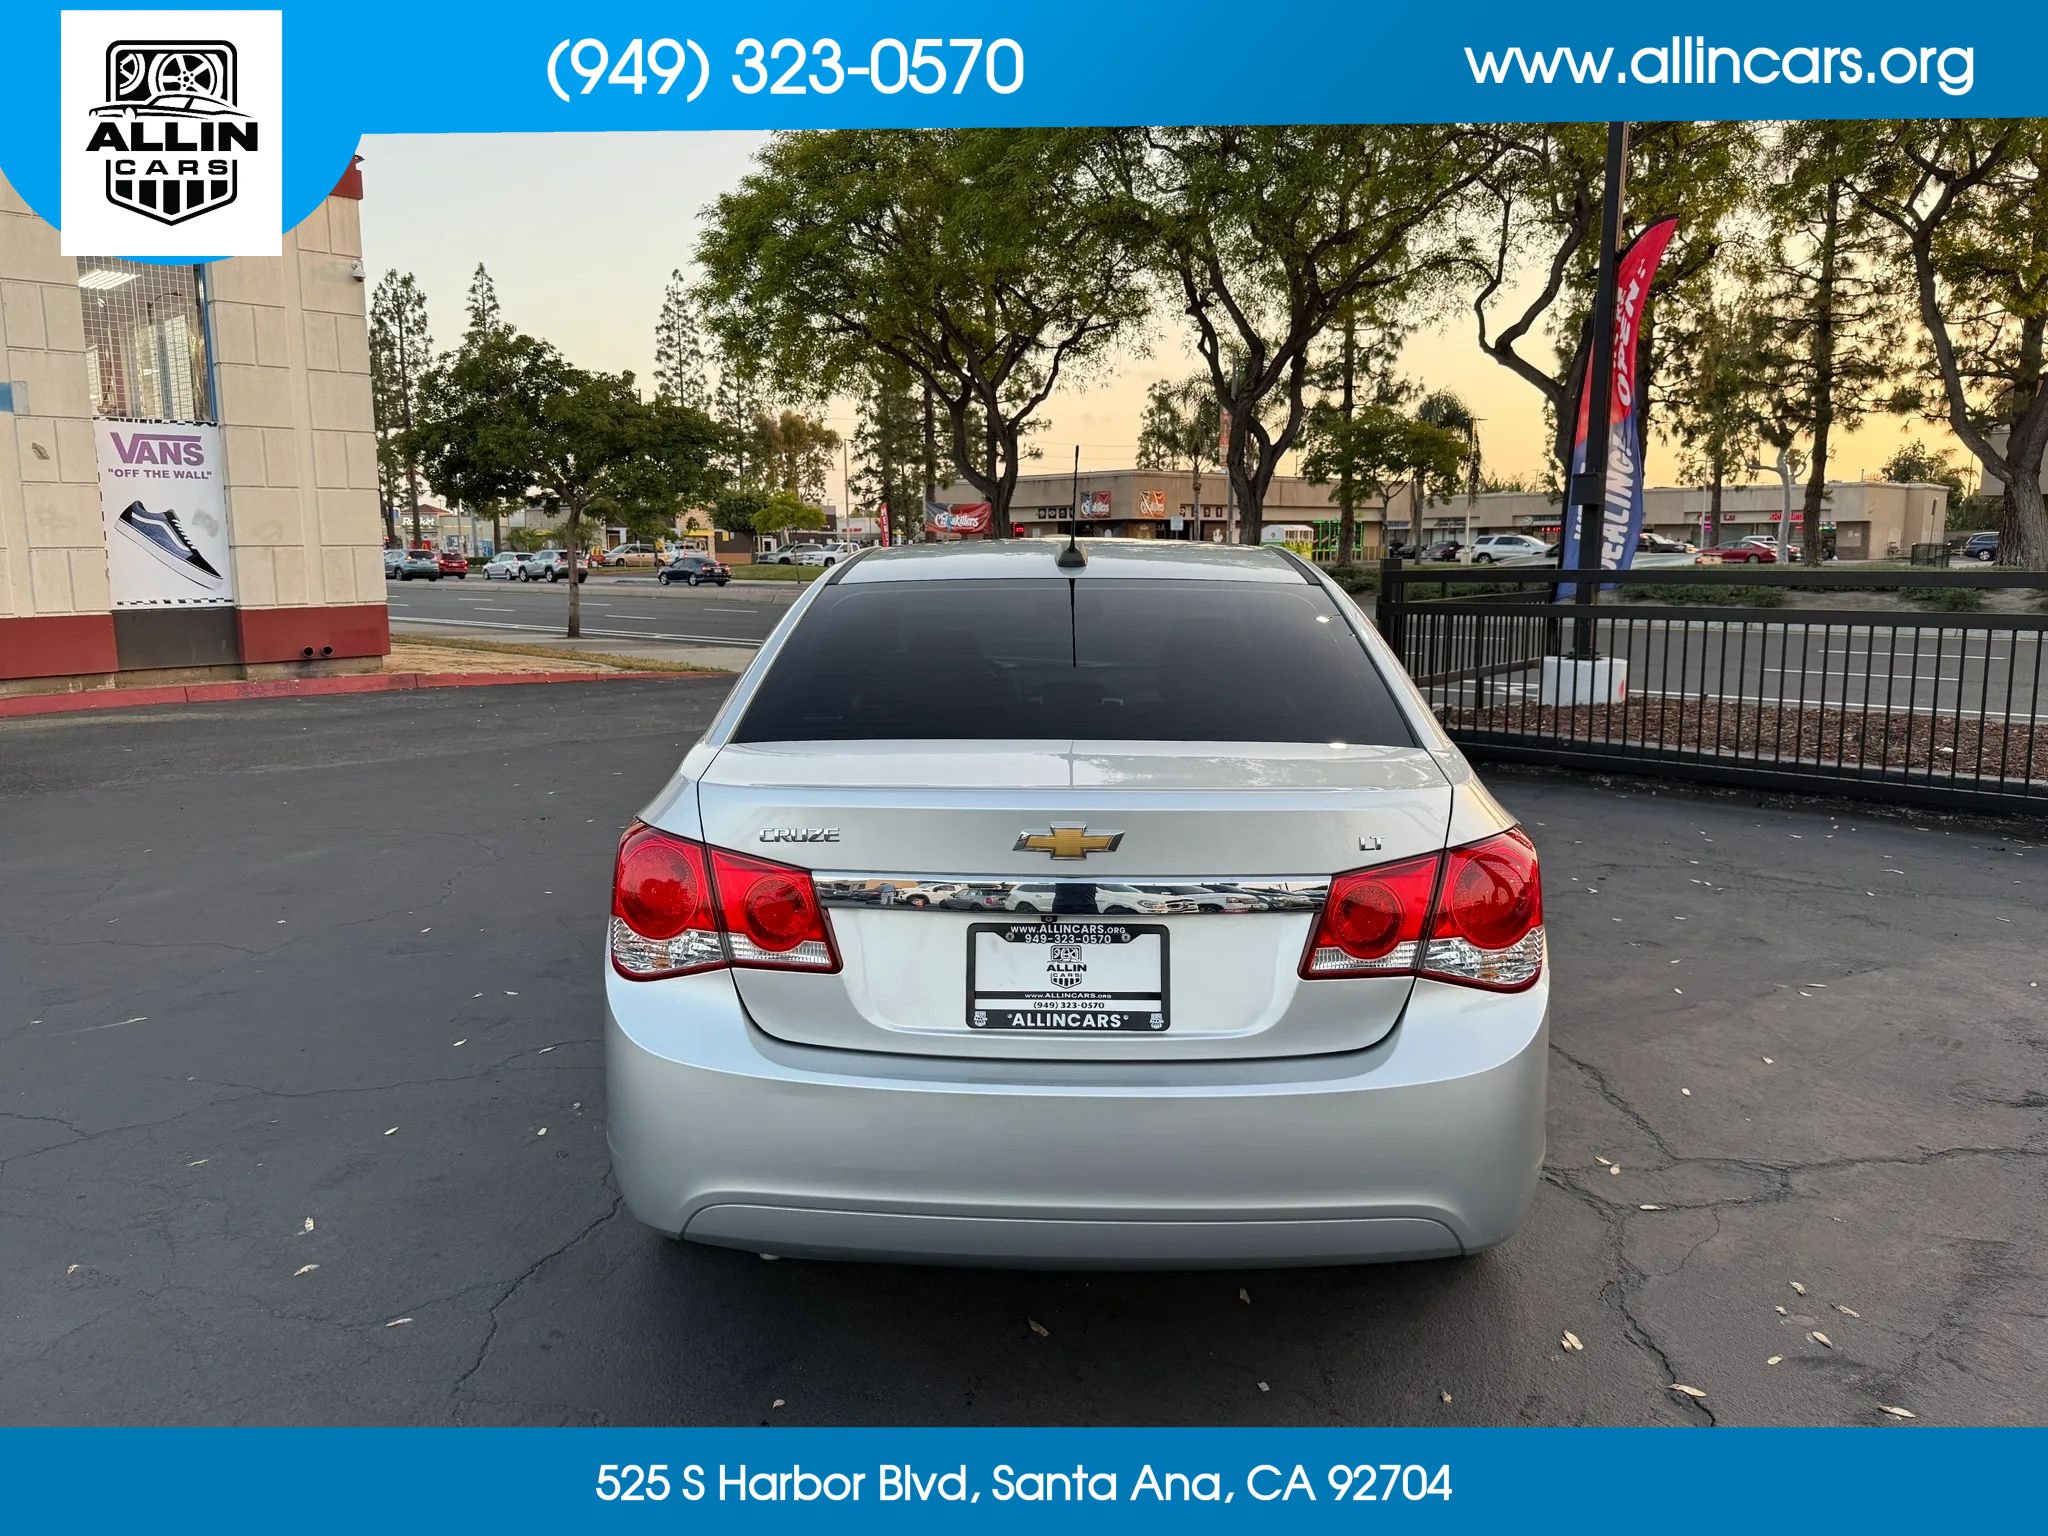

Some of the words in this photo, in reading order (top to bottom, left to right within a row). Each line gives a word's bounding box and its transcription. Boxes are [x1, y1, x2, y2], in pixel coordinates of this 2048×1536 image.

[110, 432, 204, 466] VANS
[108, 468, 140, 478] "OFF
[143, 469, 170, 478] THE
[173, 470, 212, 480] WALL"
[402, 517, 435, 526] Roket
[759, 828, 840, 842] CRUZE
[1359, 836, 1386, 851] LT
[1025, 933, 1112, 944] 949-323-0570
[1046, 964, 1088, 972] ALLIN
[1033, 1001, 1059, 1009] (949)
[1060, 1001, 1105, 1009] 323-0570
[1011, 1012, 1122, 1028] ALLINCARS
